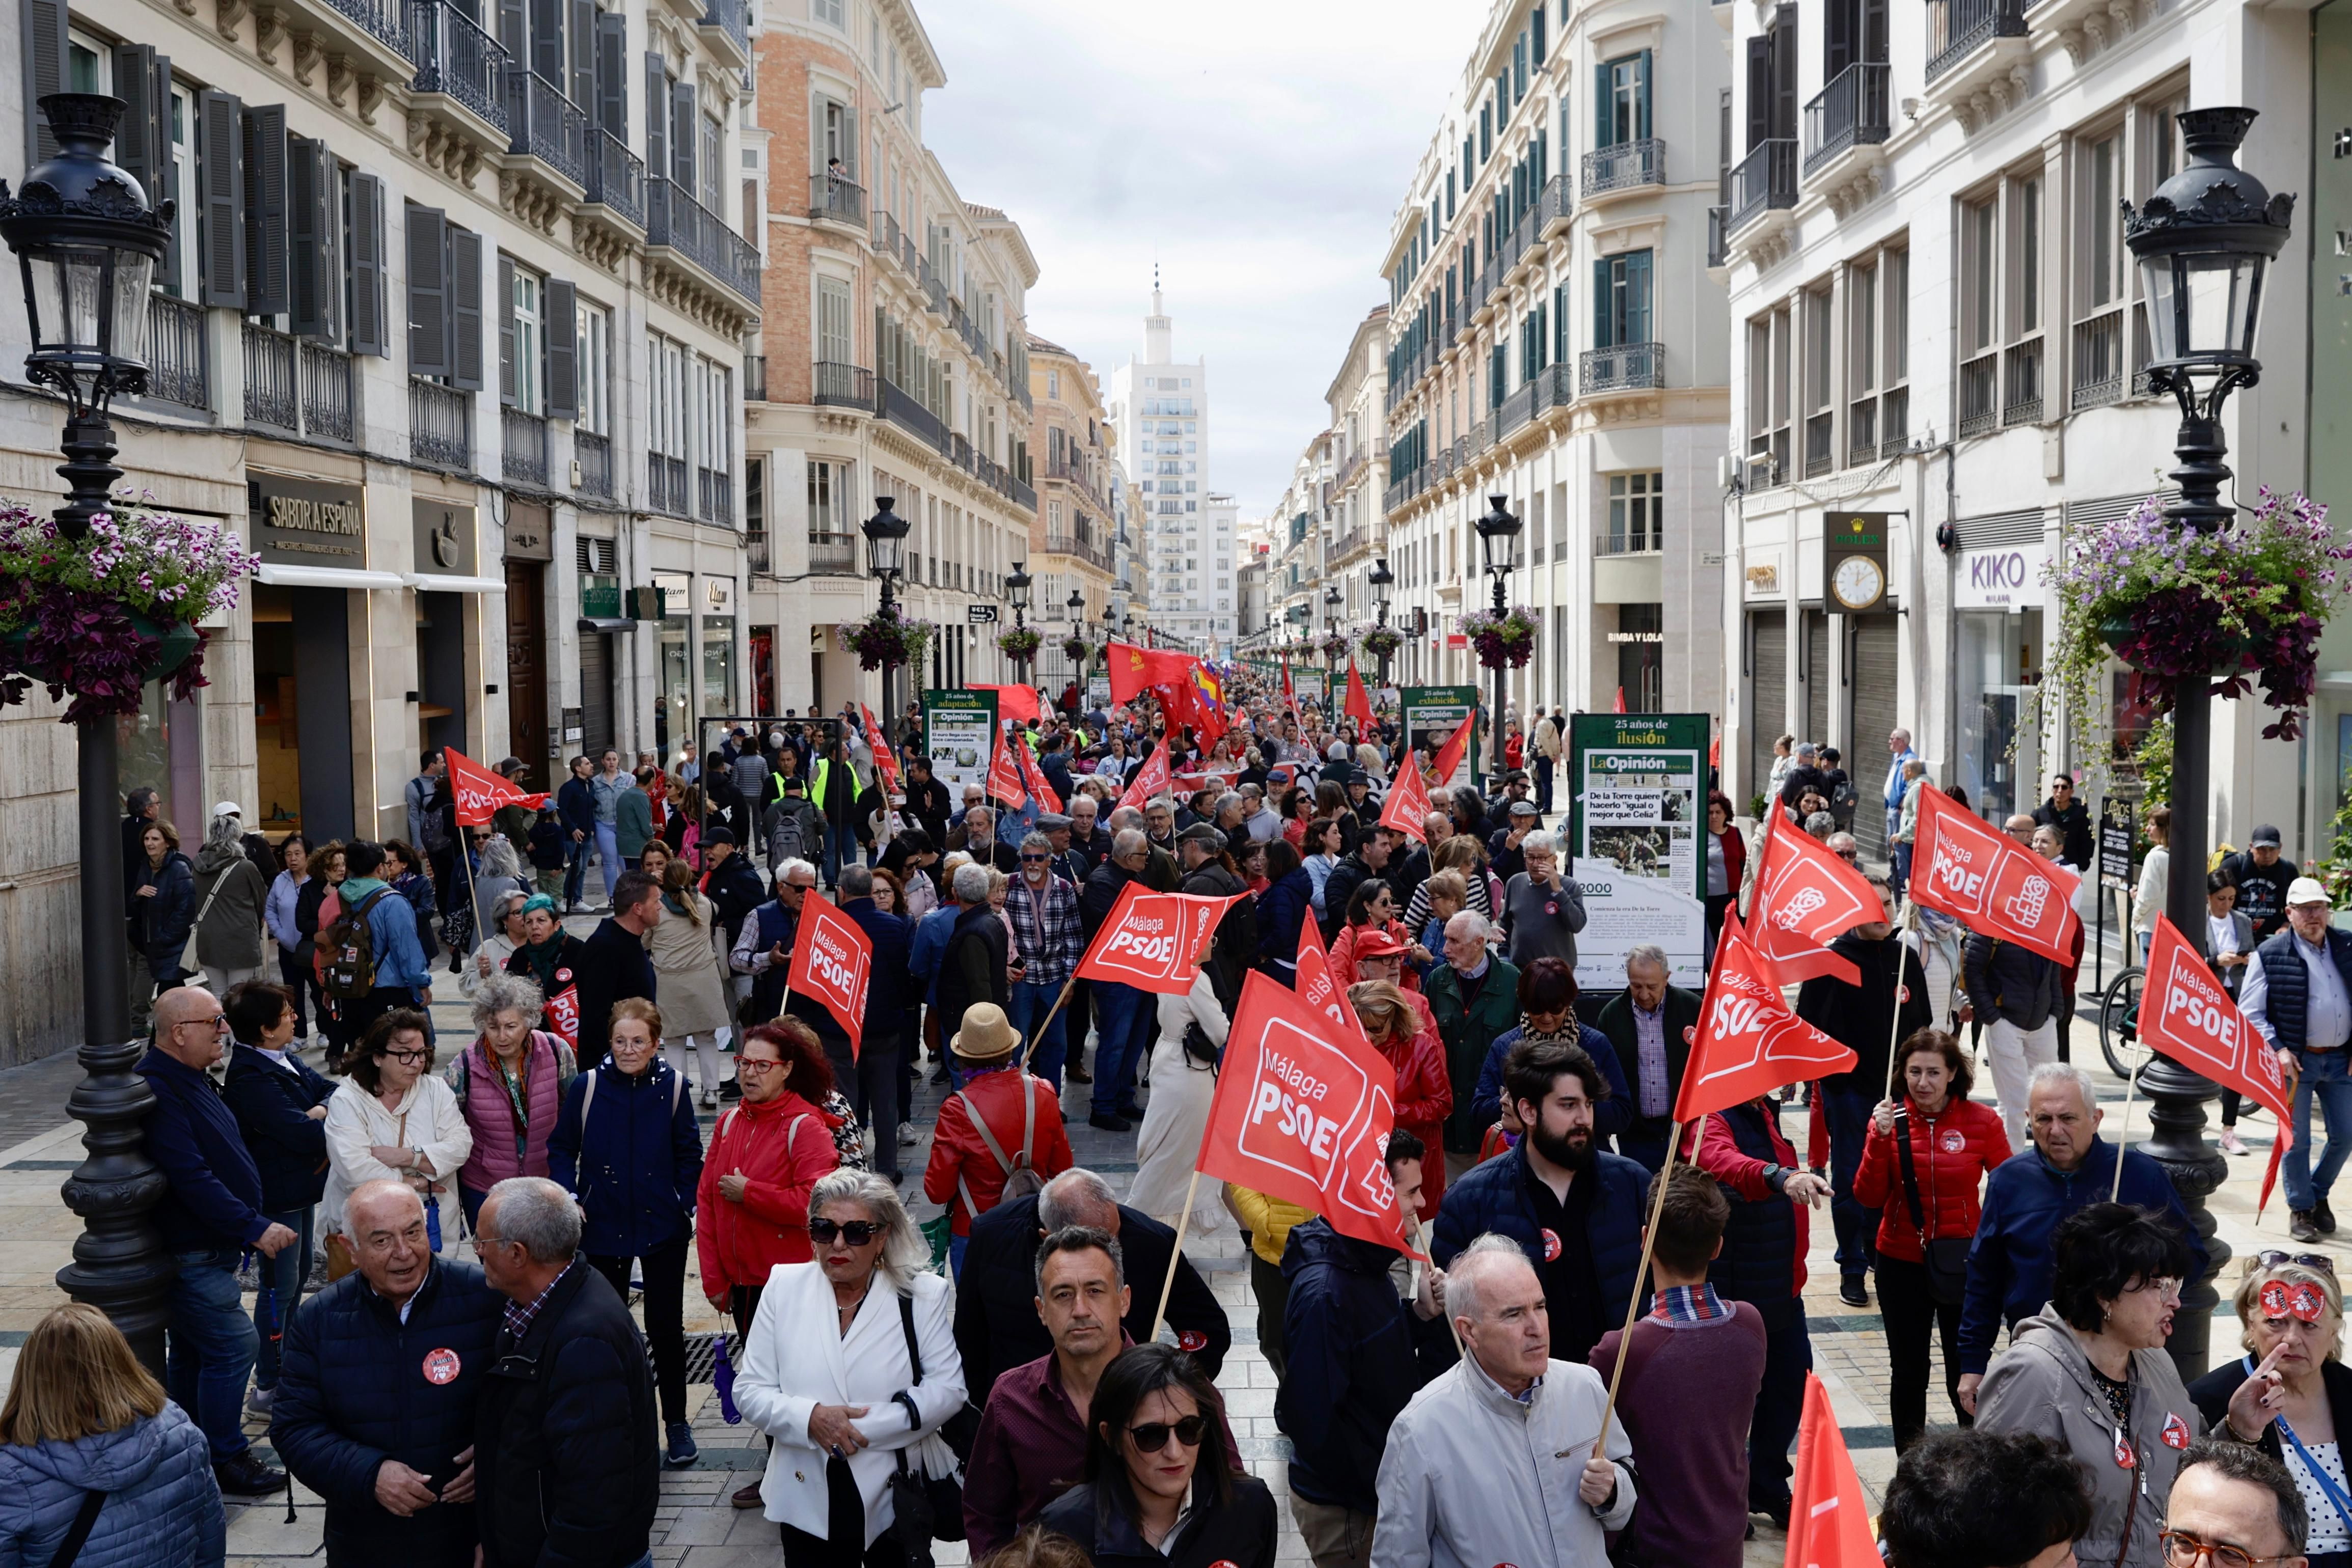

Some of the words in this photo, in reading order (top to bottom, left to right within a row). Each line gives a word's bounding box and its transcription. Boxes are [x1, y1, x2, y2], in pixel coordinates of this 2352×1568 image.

[270, 496, 311, 530] SABOR
[313, 501, 321, 531] A
[322, 500, 361, 535] ESPAÑA
[1835, 535, 1880, 545] ROLEX
[1972, 552, 2025, 589] KIKO
[590, 590, 604, 603] BODY
[604, 590, 619, 603] SHOP
[664, 587, 686, 595] tam
[707, 579, 727, 604] Etam
[1985, 594, 2011, 604] MILANO
[1608, 632, 1634, 642] BIMBA
[1635, 632, 1642, 642] Y
[1643, 632, 1664, 642] LOLA
[938, 699, 981, 709] adaptación
[1418, 696, 1460, 705] exhibición
[1615, 720, 1627, 729] 25
[1629, 720, 1654, 729] años
[1656, 719, 1669, 729] de
[1617, 729, 1665, 745] ilusión
[1634, 792, 1660, 801] quiere
[1590, 811, 1614, 819] mejor
[1616, 812, 1631, 820] que
[1934, 848, 1983, 900] PSOE
[1579, 883, 1612, 893] 2000
[1125, 916, 1163, 934] Málaga
[815, 930, 847, 962] Málaga
[1109, 931, 1174, 962] PSOE
[812, 947, 854, 995] PSOE
[2175, 965, 2221, 1005] Málaga
[2169, 986, 2236, 1049] PSOE
[1265, 1048, 1328, 1102] Málaga
[1252, 1081, 1339, 1161] PSOE
[2269, 1290, 2278, 1309] PSOE
[2278, 1293, 2287, 1310] MAYO
[2297, 1294, 2312, 1312] PSOE
[2306, 1294, 2319, 1308] MAYO
[433, 1365, 450, 1373] PSOE
[436, 1357, 452, 1365] MAYO
